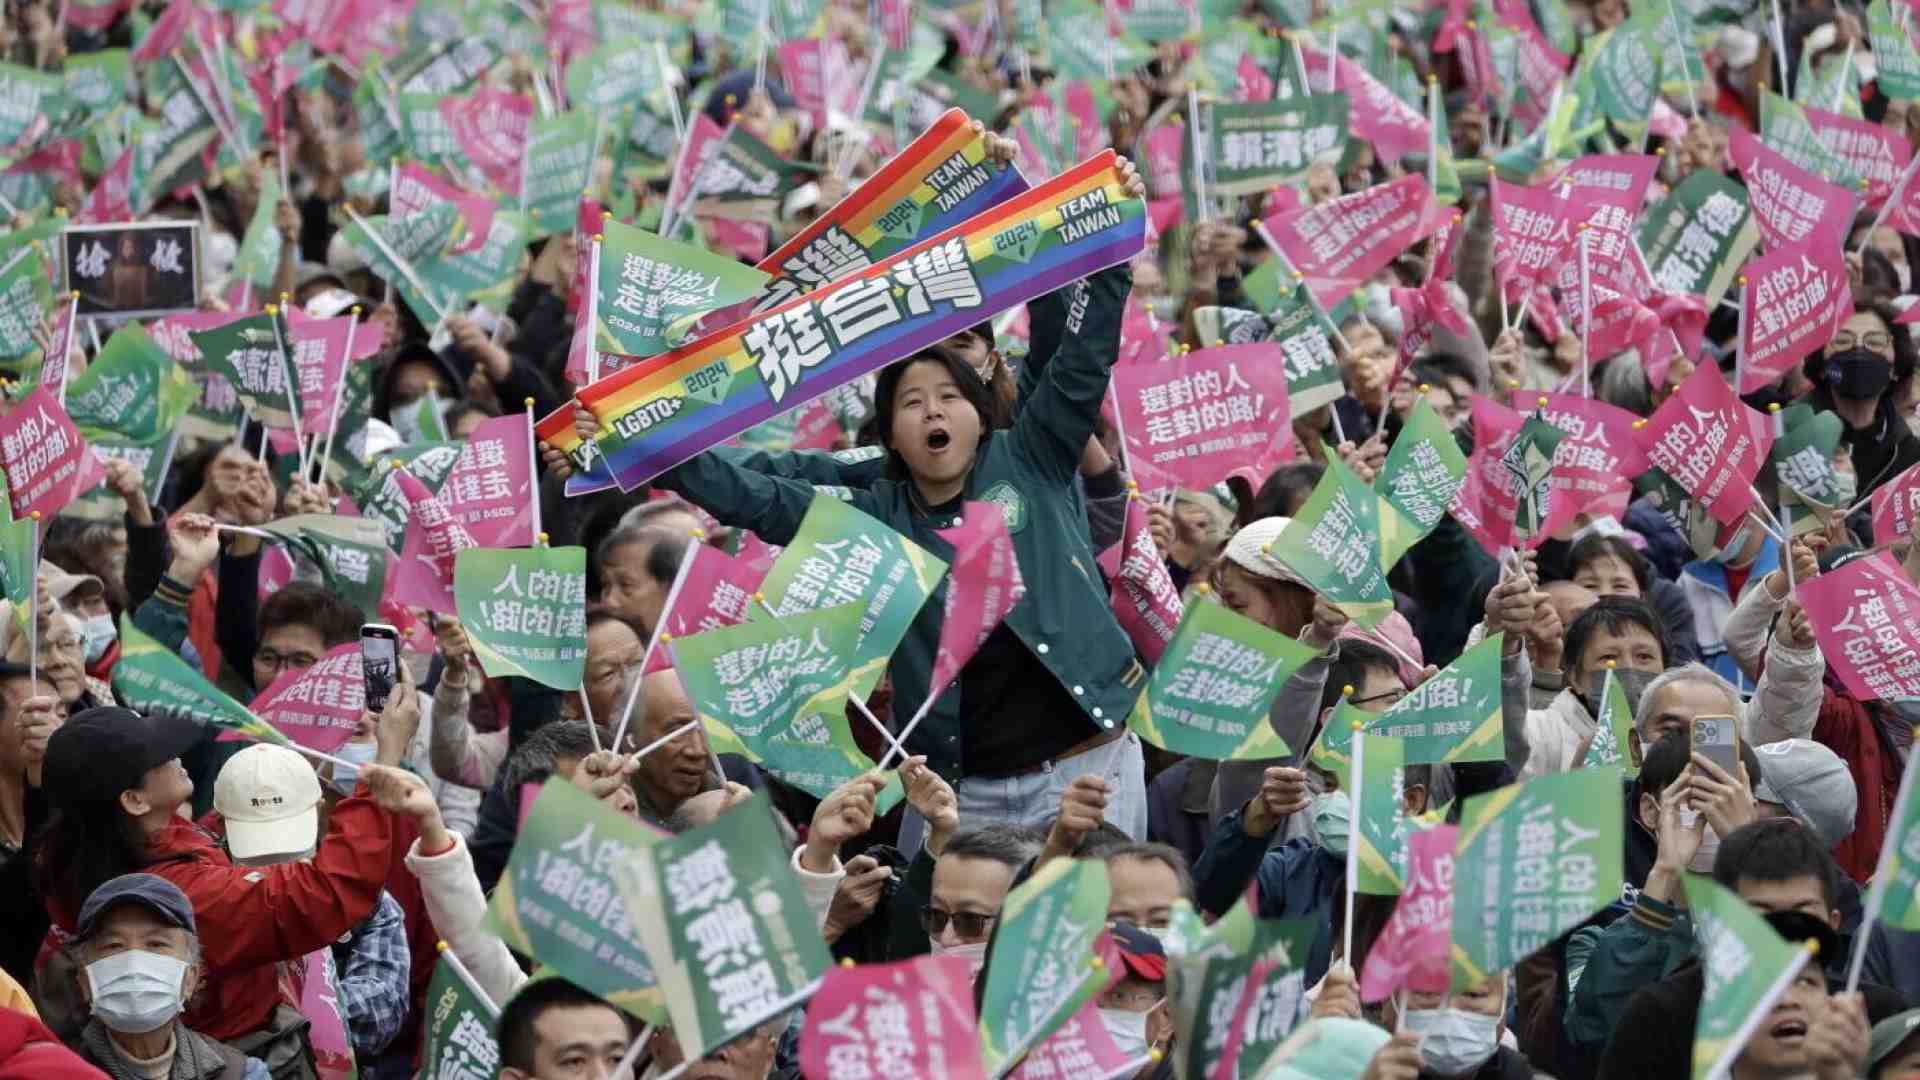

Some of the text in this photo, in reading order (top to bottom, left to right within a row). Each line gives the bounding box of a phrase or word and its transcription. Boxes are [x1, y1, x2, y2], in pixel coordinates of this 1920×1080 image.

[925, 152, 969, 190] TEAM
[935, 166, 989, 213] TAIWAN
[878, 201, 919, 232] 2024
[1057, 205, 1121, 243] TAIWAN
[1059, 189, 1106, 220] TEAM
[993, 220, 1038, 250] 2024
[622, 252, 721, 297] 選對的人
[608, 315, 640, 334] 2024
[745, 236, 983, 404] 挺台灣
[685, 362, 729, 393] 2024
[1139, 363, 1250, 416] 選對的人
[616, 397, 682, 438] LGBTQ+
[1146, 394, 1265, 446] 走對的路!
[1551, 442, 1618, 473] 的路!
[713, 627, 830, 685] 選對的人
[1185, 631, 1283, 685] 選對的人
